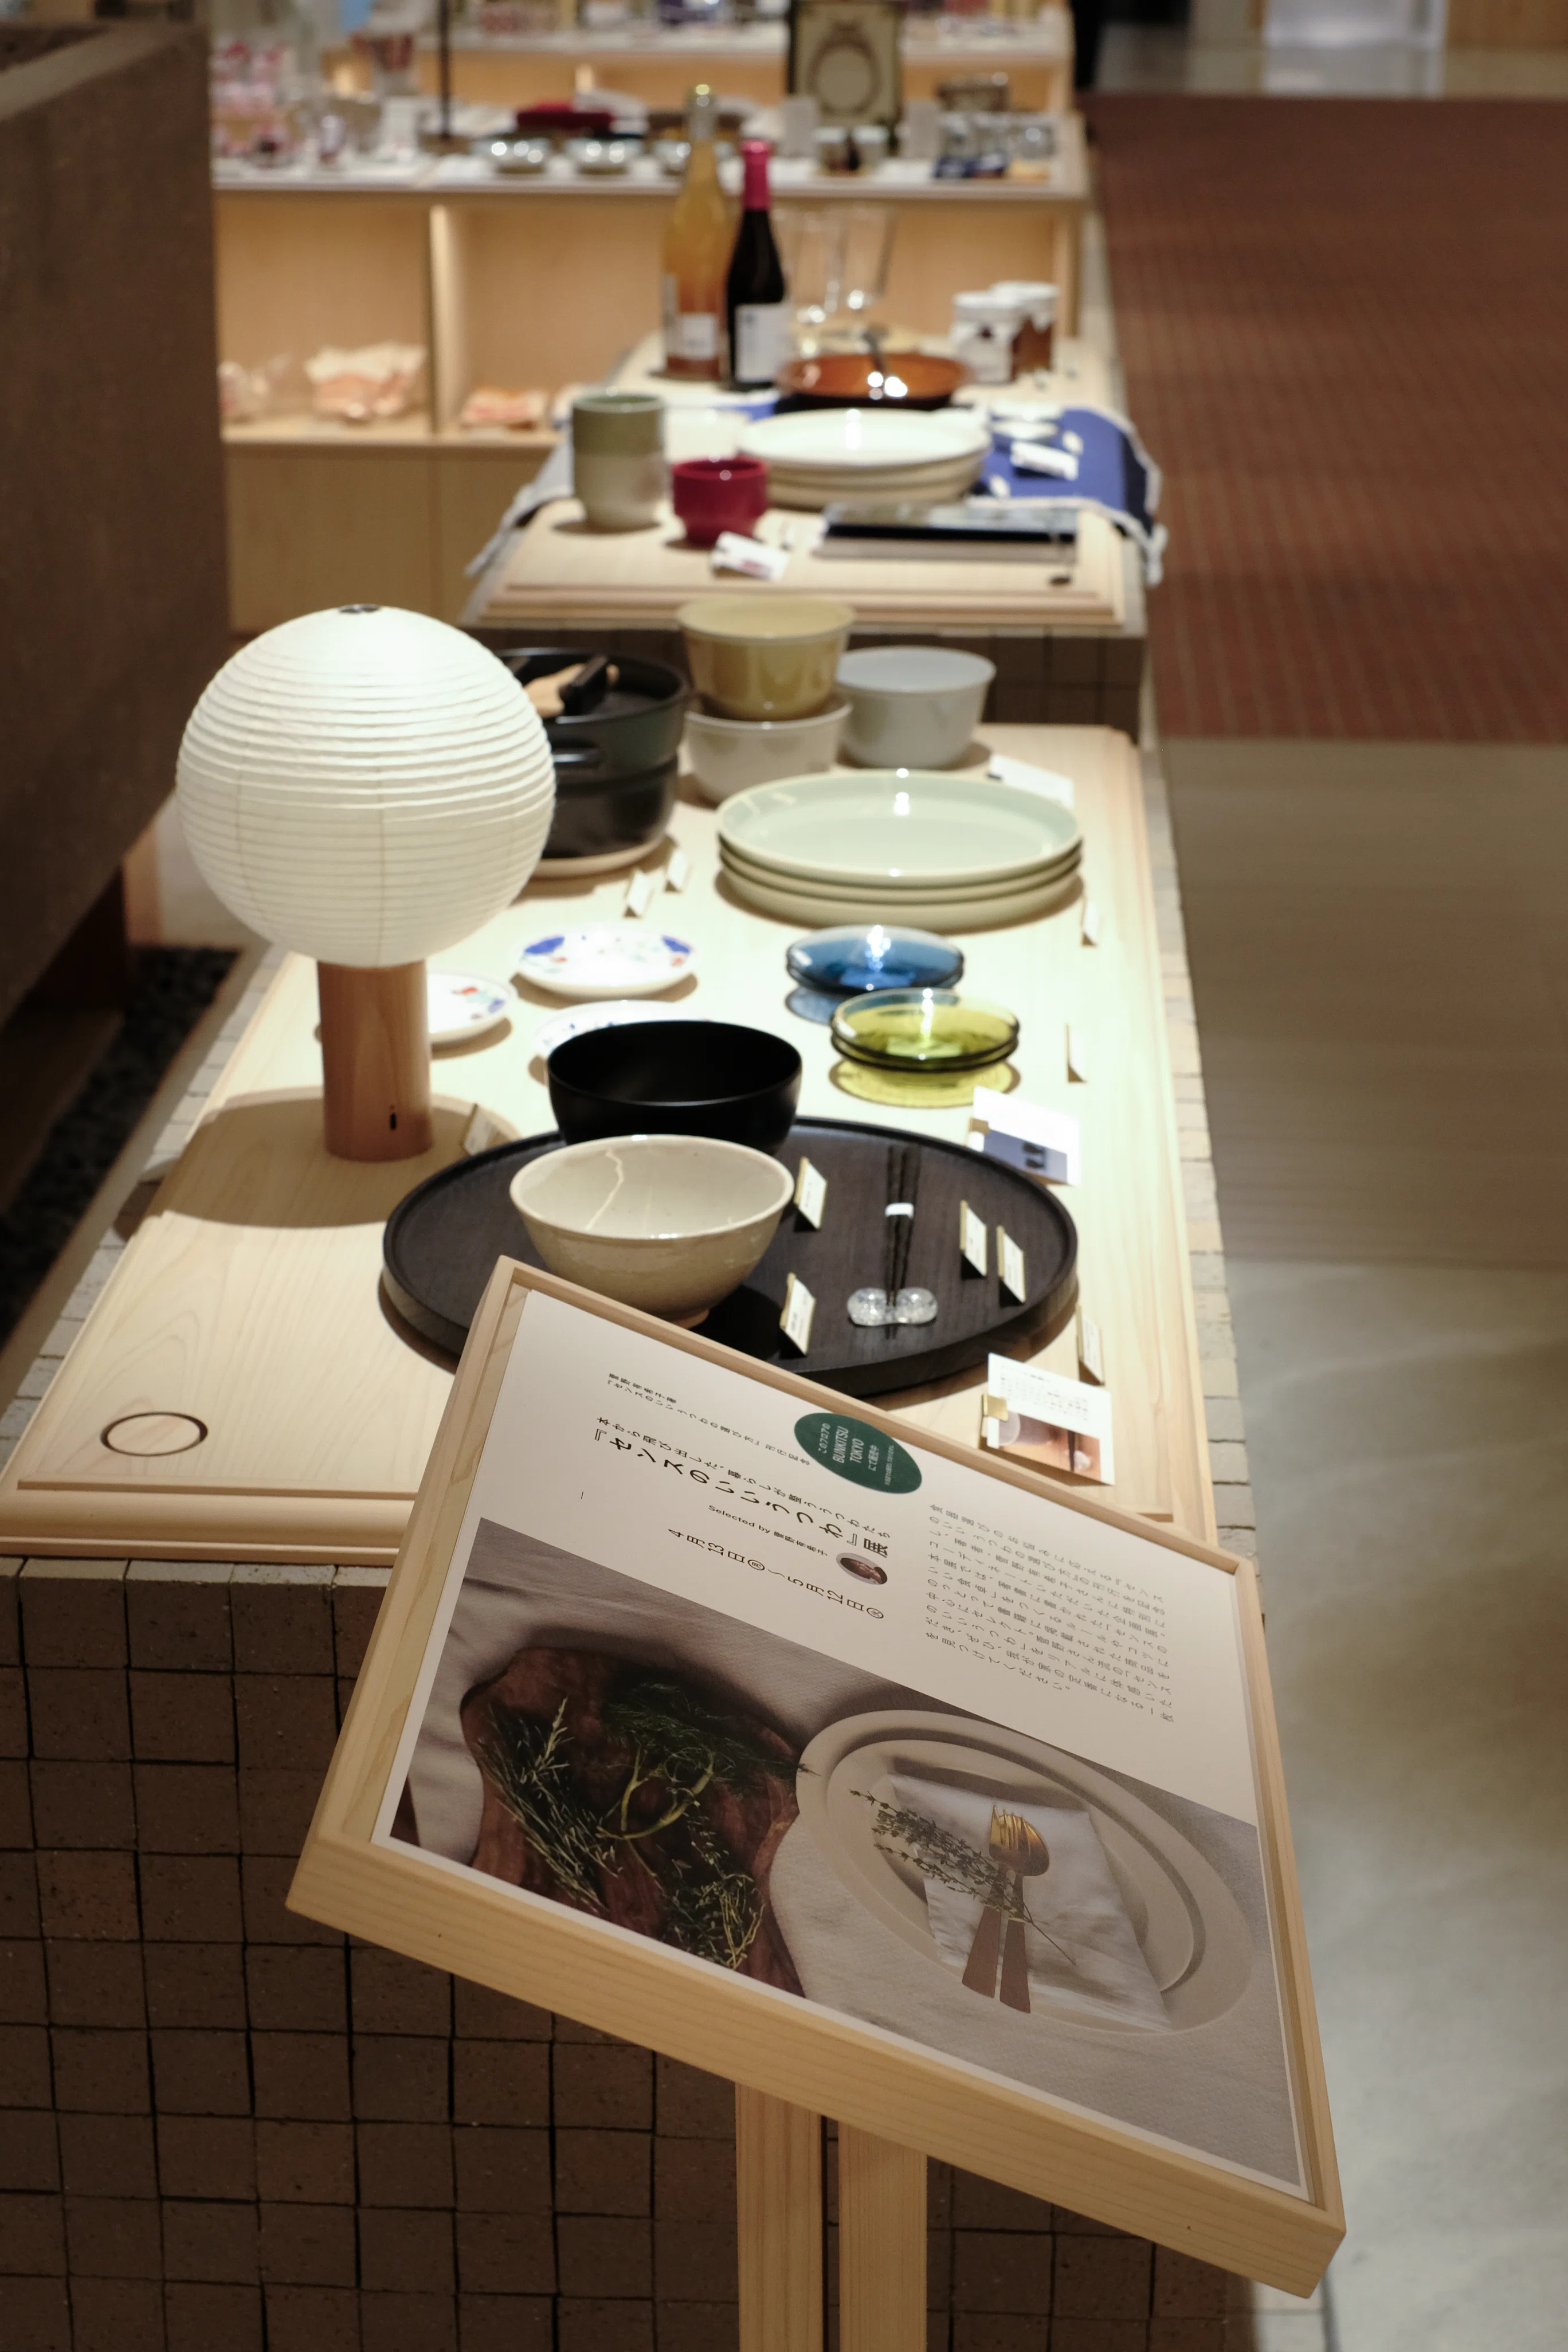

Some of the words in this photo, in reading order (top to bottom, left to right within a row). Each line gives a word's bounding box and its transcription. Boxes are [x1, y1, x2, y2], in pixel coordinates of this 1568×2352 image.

[832, 1426, 849, 1464] BUNKITSU
[850, 1438, 864, 1463] TOKYO
[594, 1429, 888, 1558] 『センスのいいうつわ』展
[708, 1505, 755, 1527] Selected
[759, 1525, 771, 1534] by
[926, 1632, 1070, 1690] を見つけてください。
